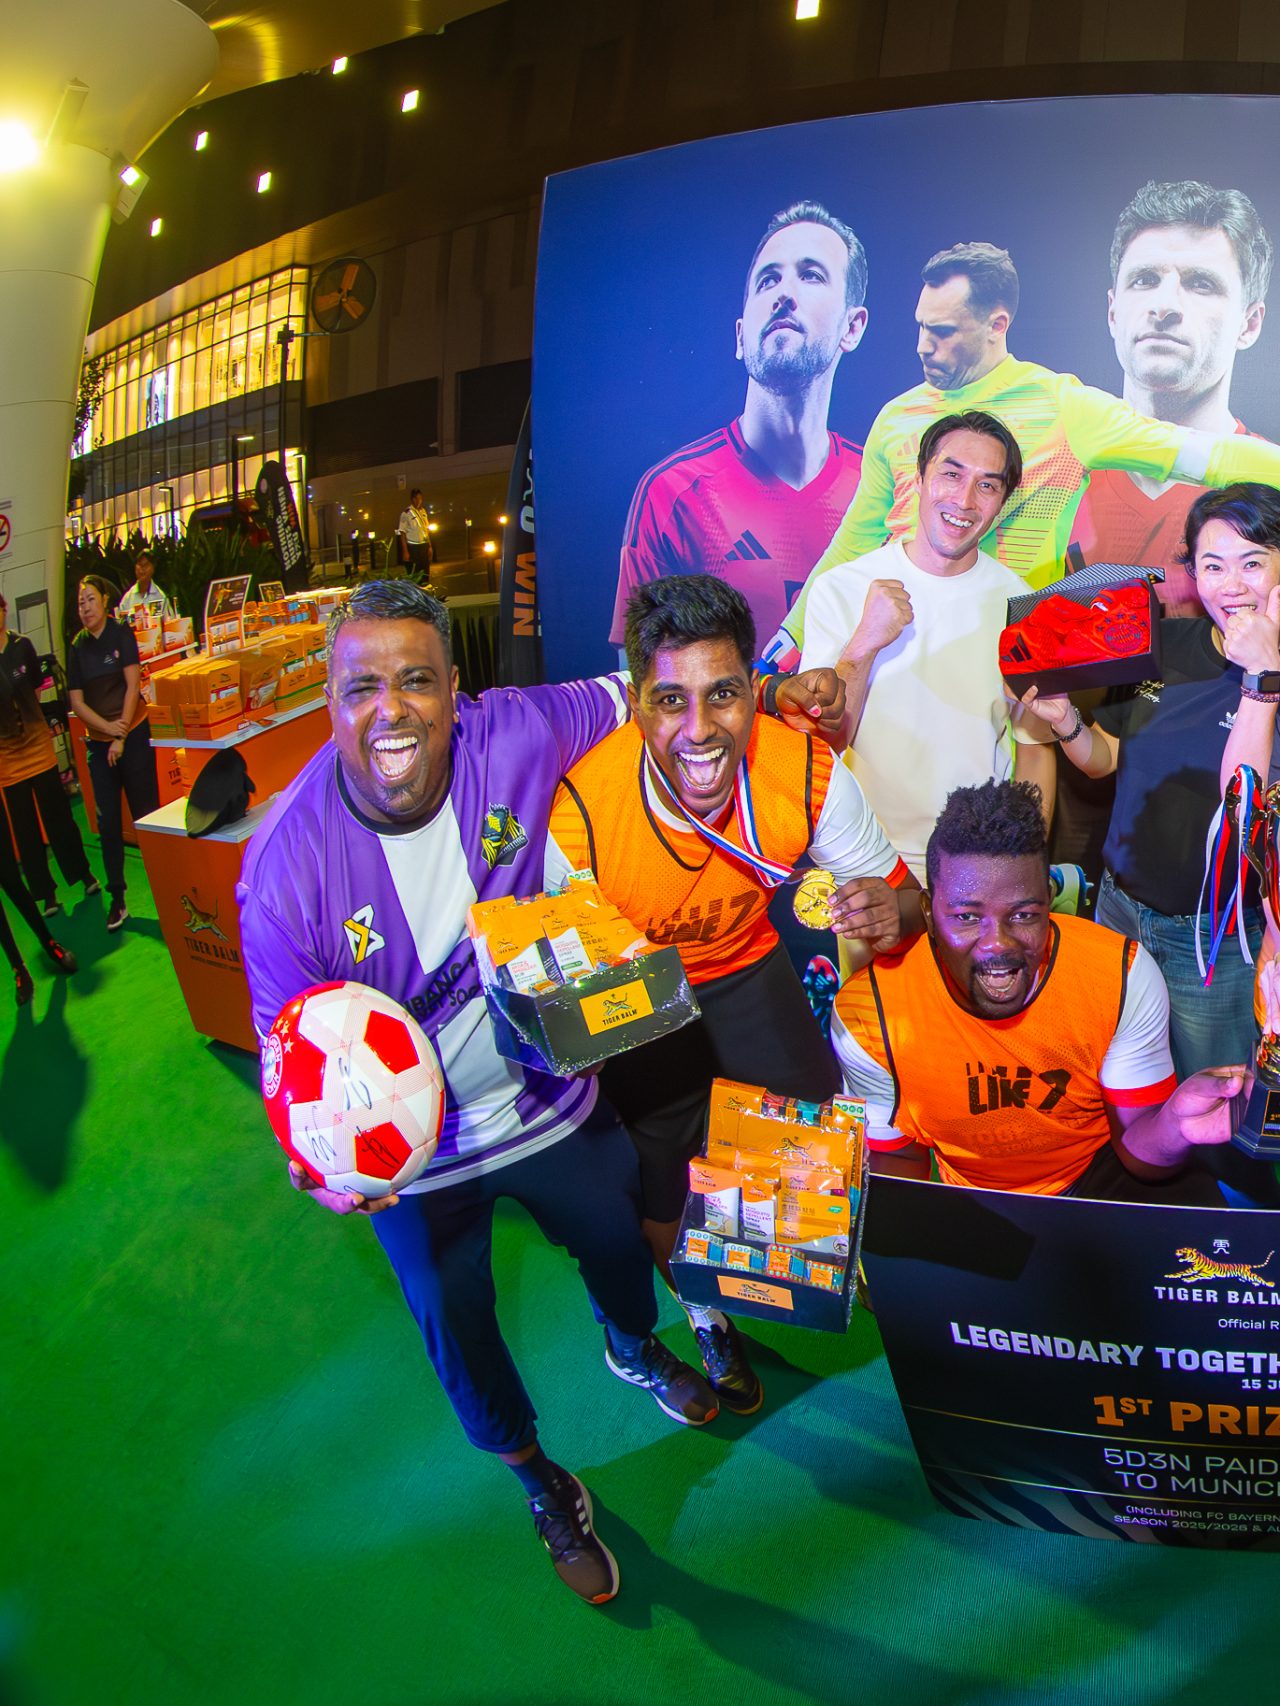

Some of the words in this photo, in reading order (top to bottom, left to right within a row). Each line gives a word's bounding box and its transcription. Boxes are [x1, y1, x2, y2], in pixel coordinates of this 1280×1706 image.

[602, 1013, 621, 1027] TIGER
[619, 1008, 639, 1021] BALM
[1038, 1068, 1073, 1113] 7
[736, 1289, 757, 1301] TIGER
[757, 1293, 777, 1304] BALM
[1153, 1286, 1219, 1303] TIGER
[1218, 1318, 1266, 1331] Official
[950, 1322, 1144, 1367] LEGENDARY
[1241, 1379, 1262, 1390] 15
[1093, 1395, 1153, 1427] 1ST
[1104, 1448, 1191, 1472] 5D3N
[1205, 1456, 1279, 1476] PAID
[1114, 1470, 1157, 1491] TO
[1126, 1505, 1203, 1519] (INCLUDING
[1206, 1511, 1224, 1520] FC
[1113, 1515, 1168, 1527] SEASON
[1172, 1520, 1248, 1532] 2025/2026
